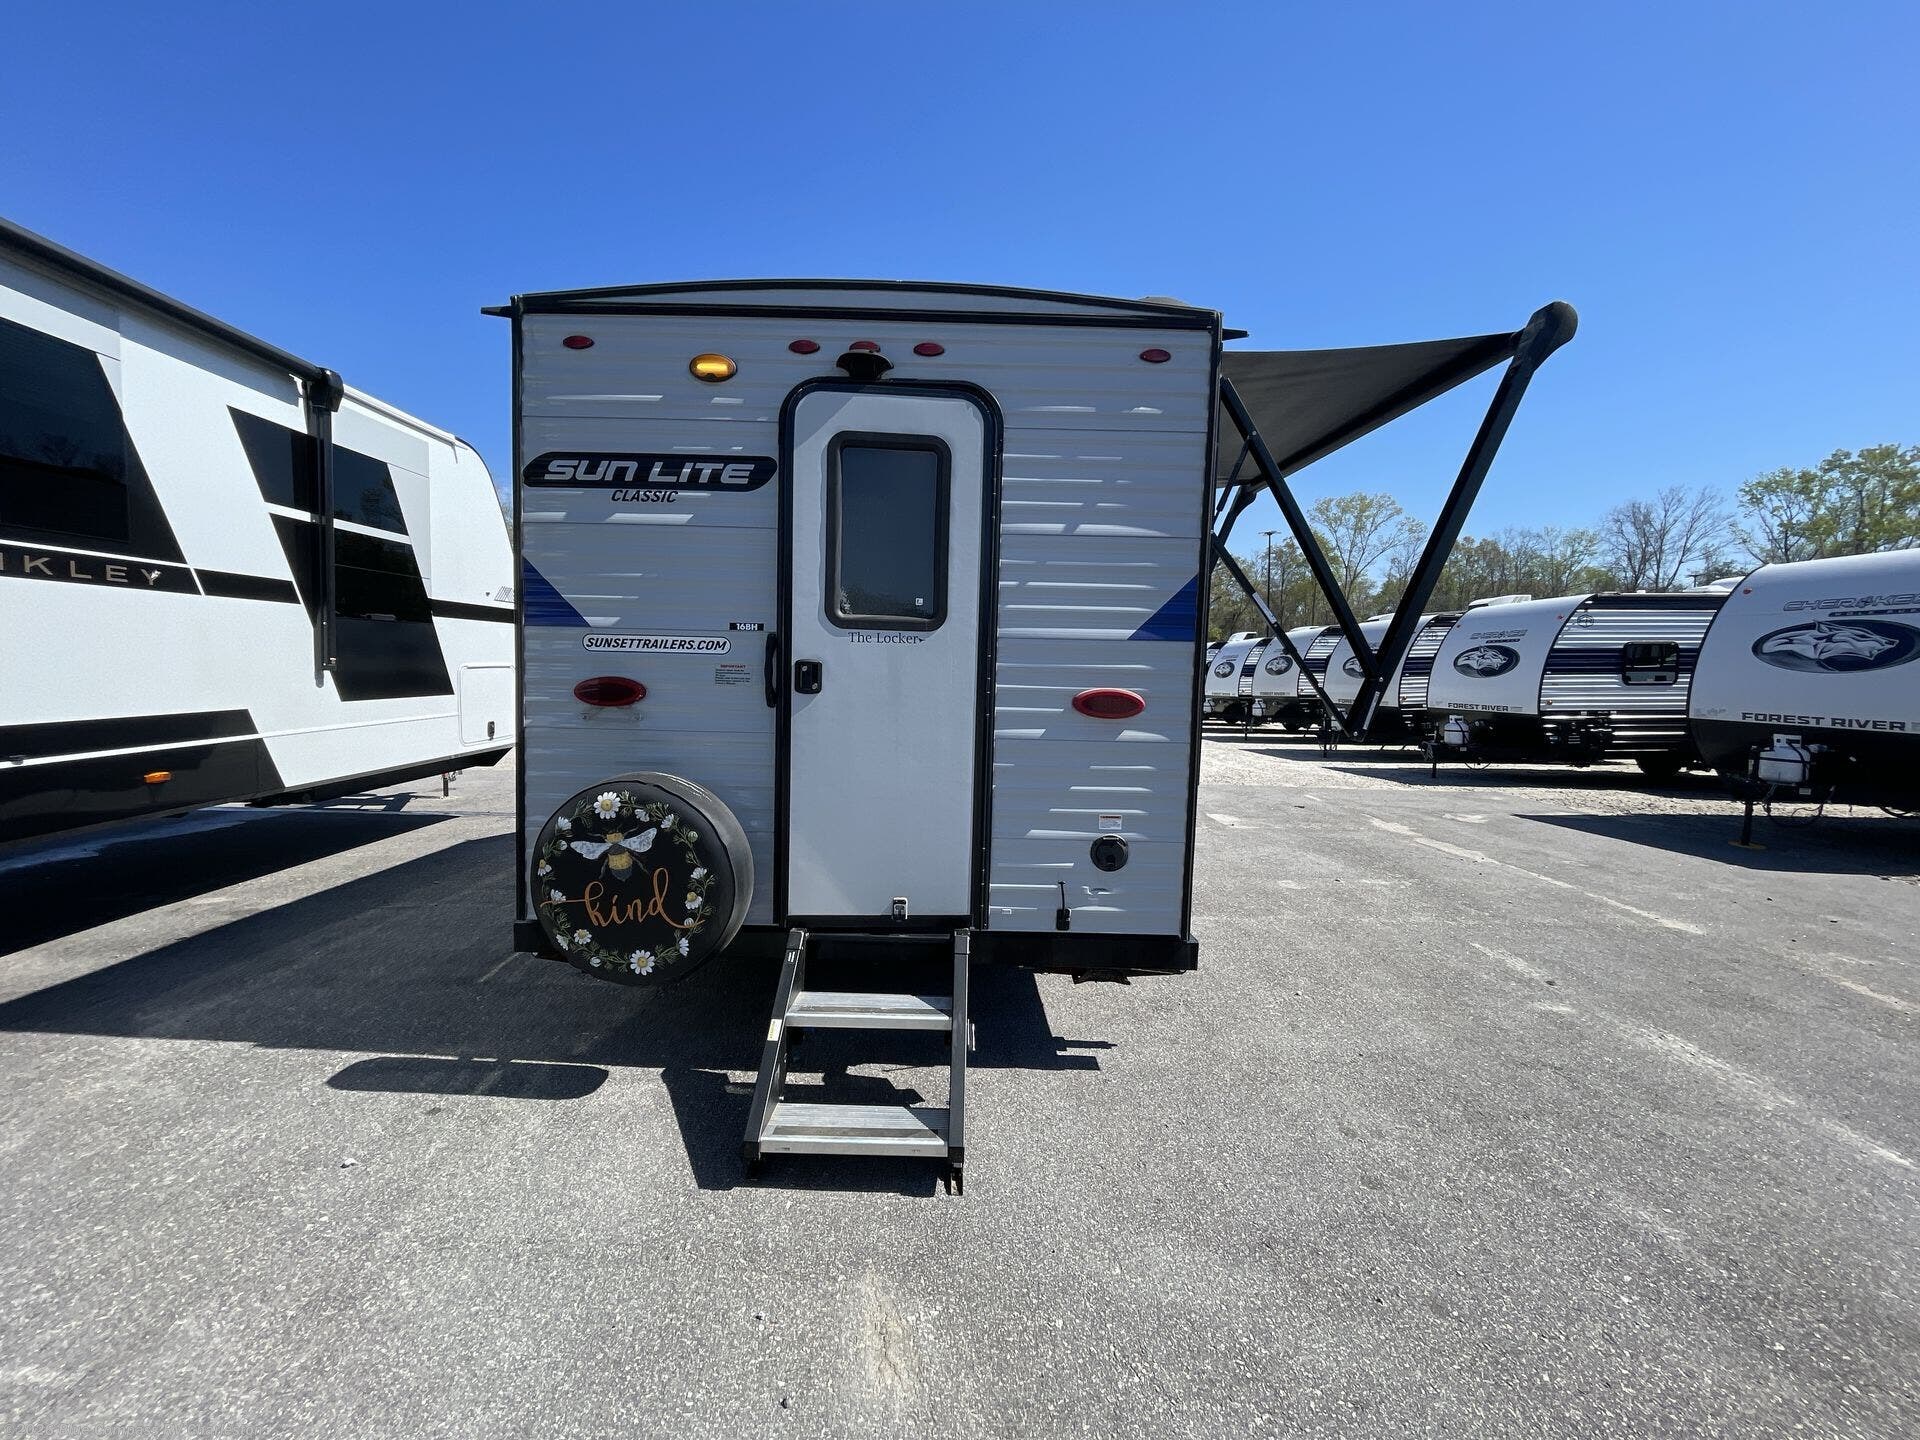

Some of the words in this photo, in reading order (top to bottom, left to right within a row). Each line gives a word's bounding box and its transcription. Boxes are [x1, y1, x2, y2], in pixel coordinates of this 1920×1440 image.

[543, 459, 639, 481] SUN
[647, 461, 755, 485] LITE
[611, 489, 679, 503] CLASSIC
[736, 623, 758, 631] 16BH
[585, 637, 728, 651] SUNSETTRAILERS.COM
[848, 631, 872, 643] The
[876, 632, 919, 644] Locker
[1447, 702, 1480, 710] FOREST
[1741, 712, 1825, 726] FOREST
[1830, 717, 1905, 731] RIVER
[540, 867, 706, 928] kind
